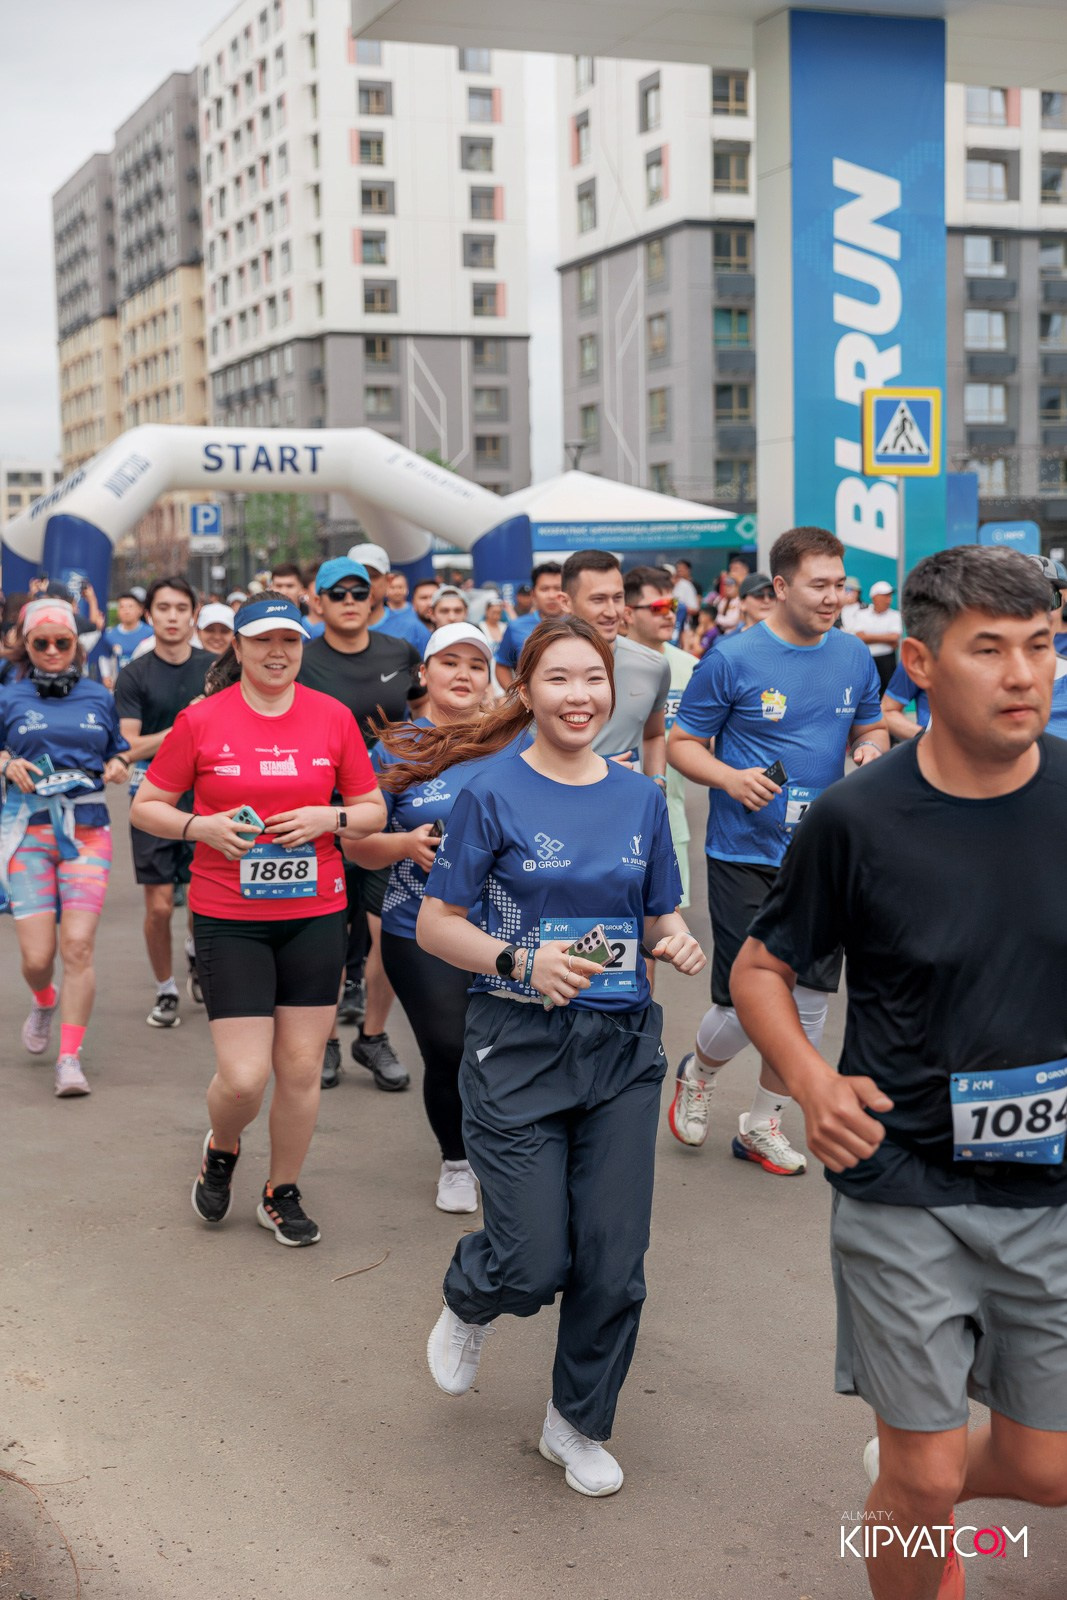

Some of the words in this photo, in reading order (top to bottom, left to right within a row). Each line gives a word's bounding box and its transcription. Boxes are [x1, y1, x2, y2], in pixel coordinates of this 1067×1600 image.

[833, 156, 902, 406] RUN
[203, 443, 323, 473] START
[197, 505, 217, 534] P
[424, 793, 451, 804] GROUP
[438, 857, 452, 870] City
[538, 860, 571, 869] GROUP
[250, 860, 309, 881] 1868
[544, 923, 552, 932] 5
[554, 924, 568, 932] KM
[958, 1079, 969, 1092] 5
[972, 1080, 994, 1091] KM
